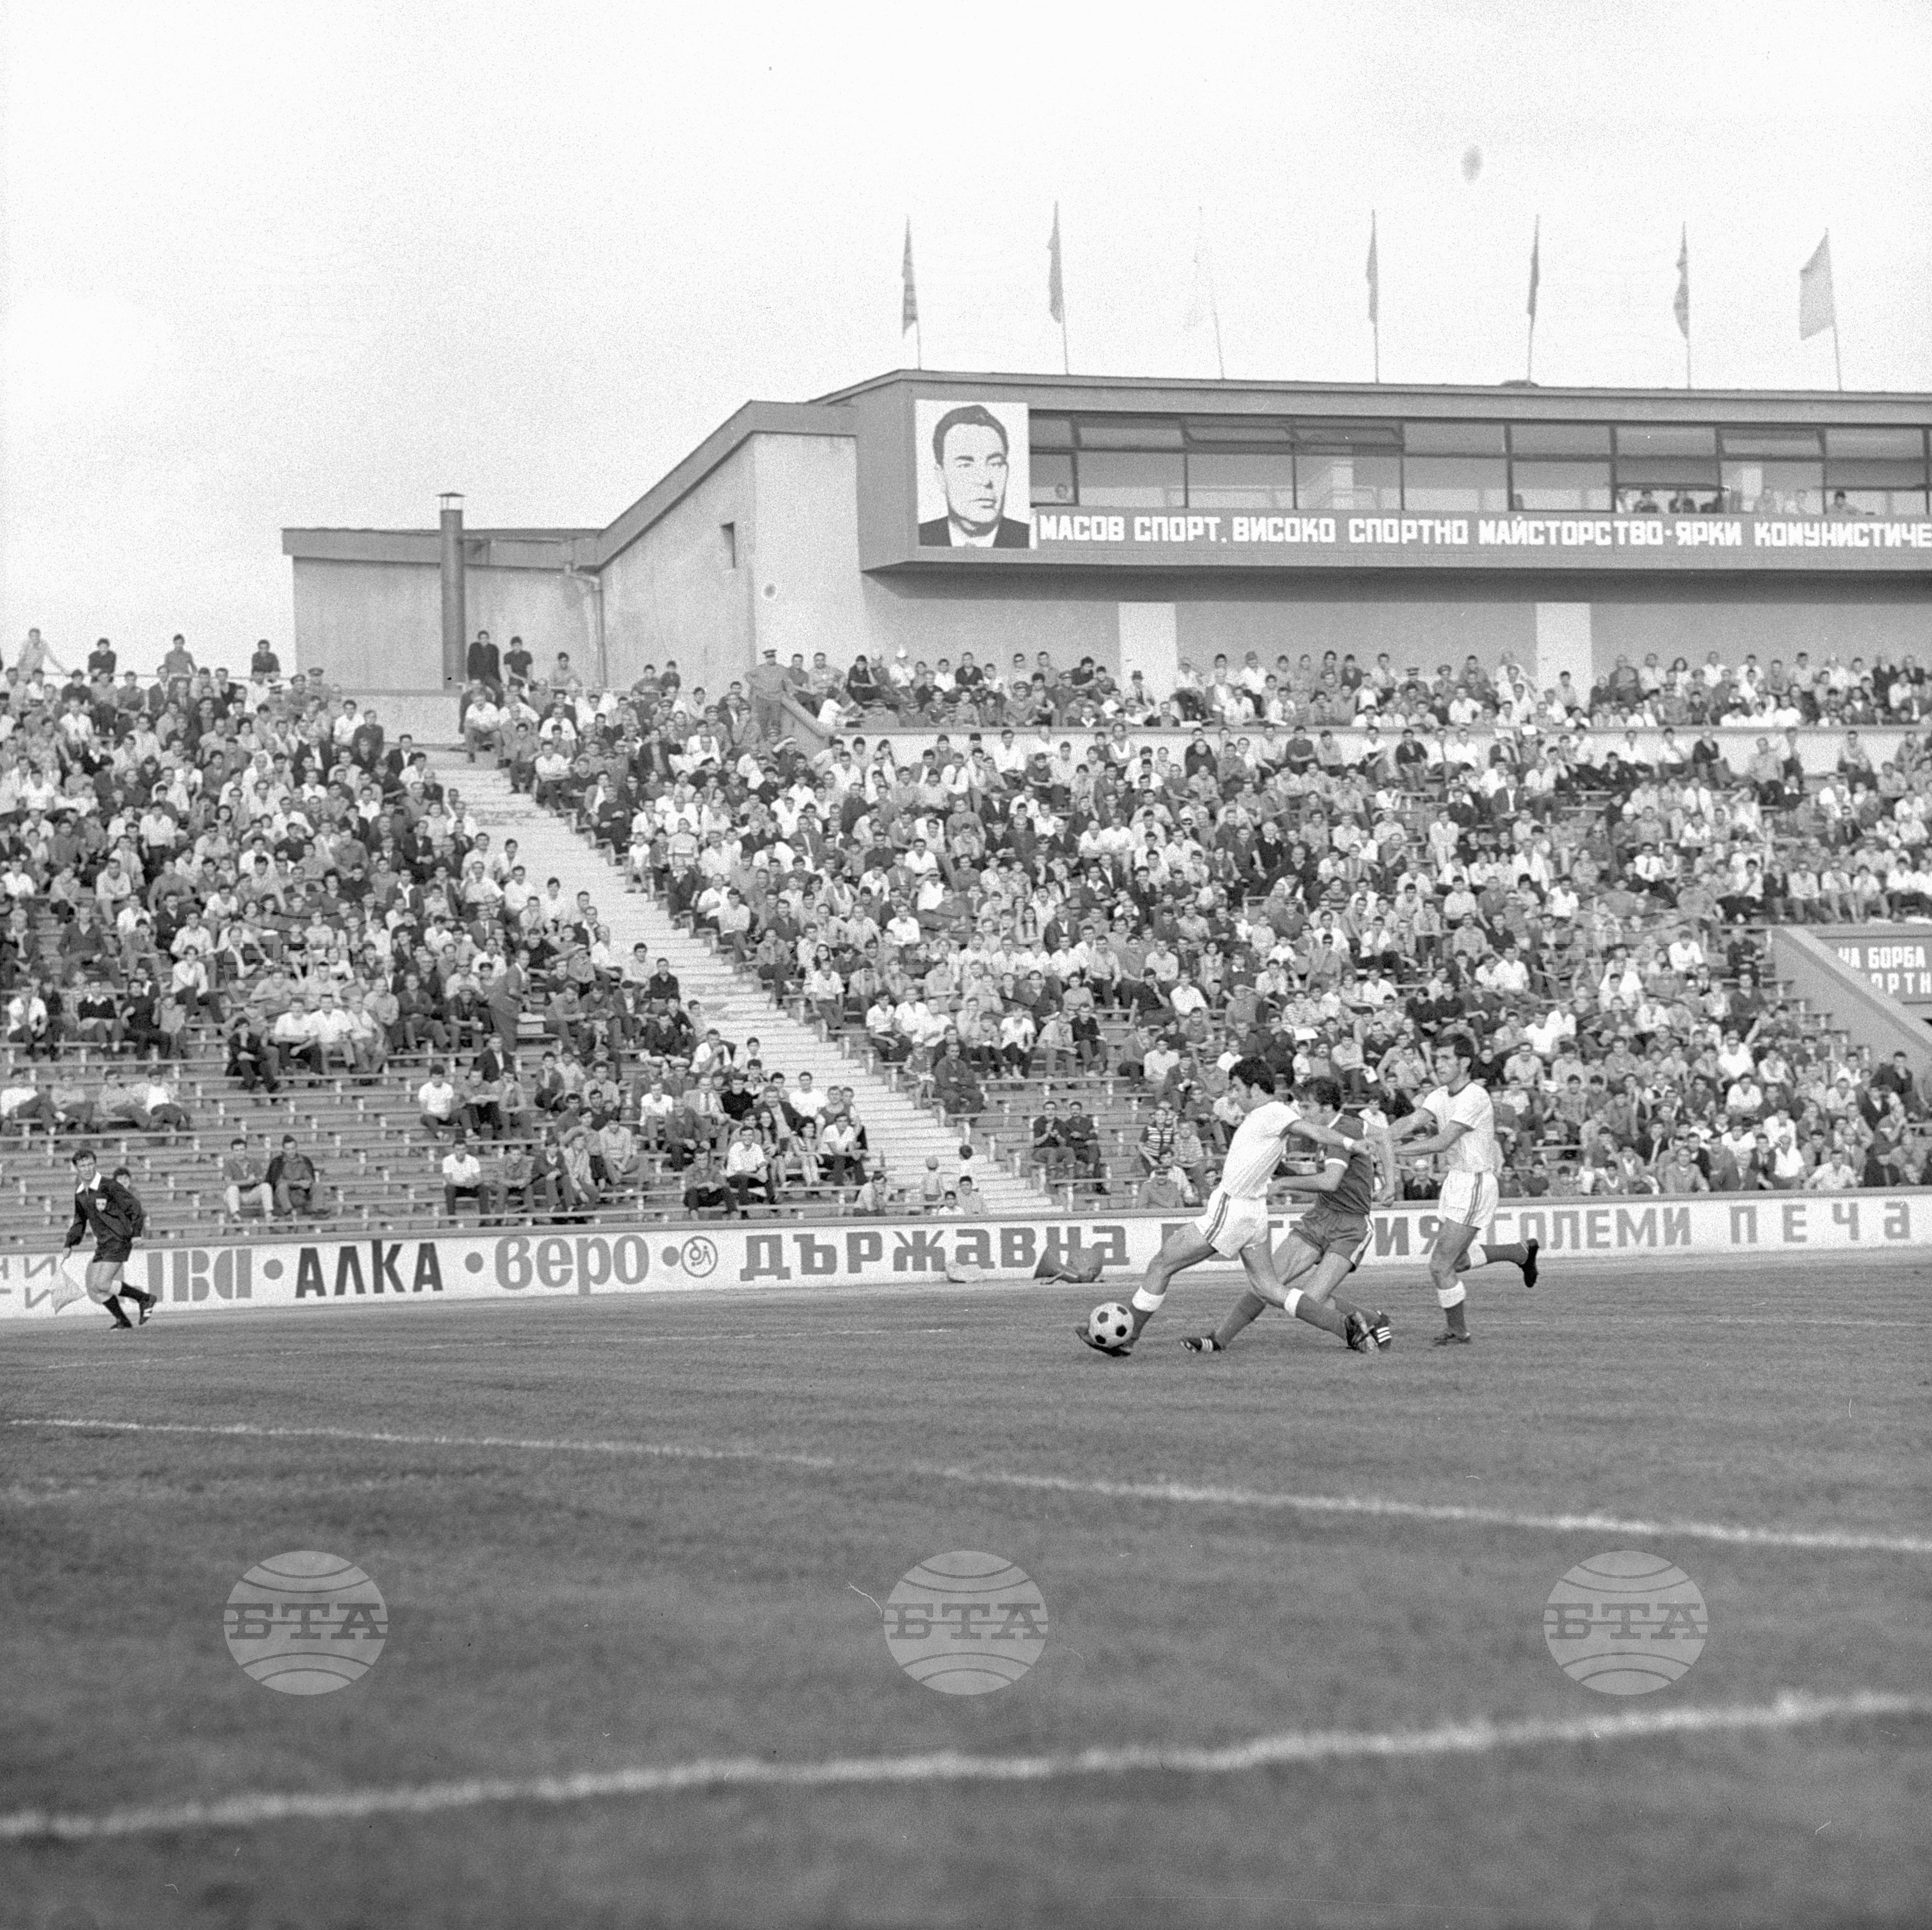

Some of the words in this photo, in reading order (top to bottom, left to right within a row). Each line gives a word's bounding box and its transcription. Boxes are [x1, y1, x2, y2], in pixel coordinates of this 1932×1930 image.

[1040, 515, 1124, 541] МАСОВ
[1233, 517, 1336, 543] ВИСОКО
[1349, 518, 1468, 545] СПОРТНО
[1868, 945, 1926, 969] БОРБА
[295, 1239, 443, 1299] АЛКА
